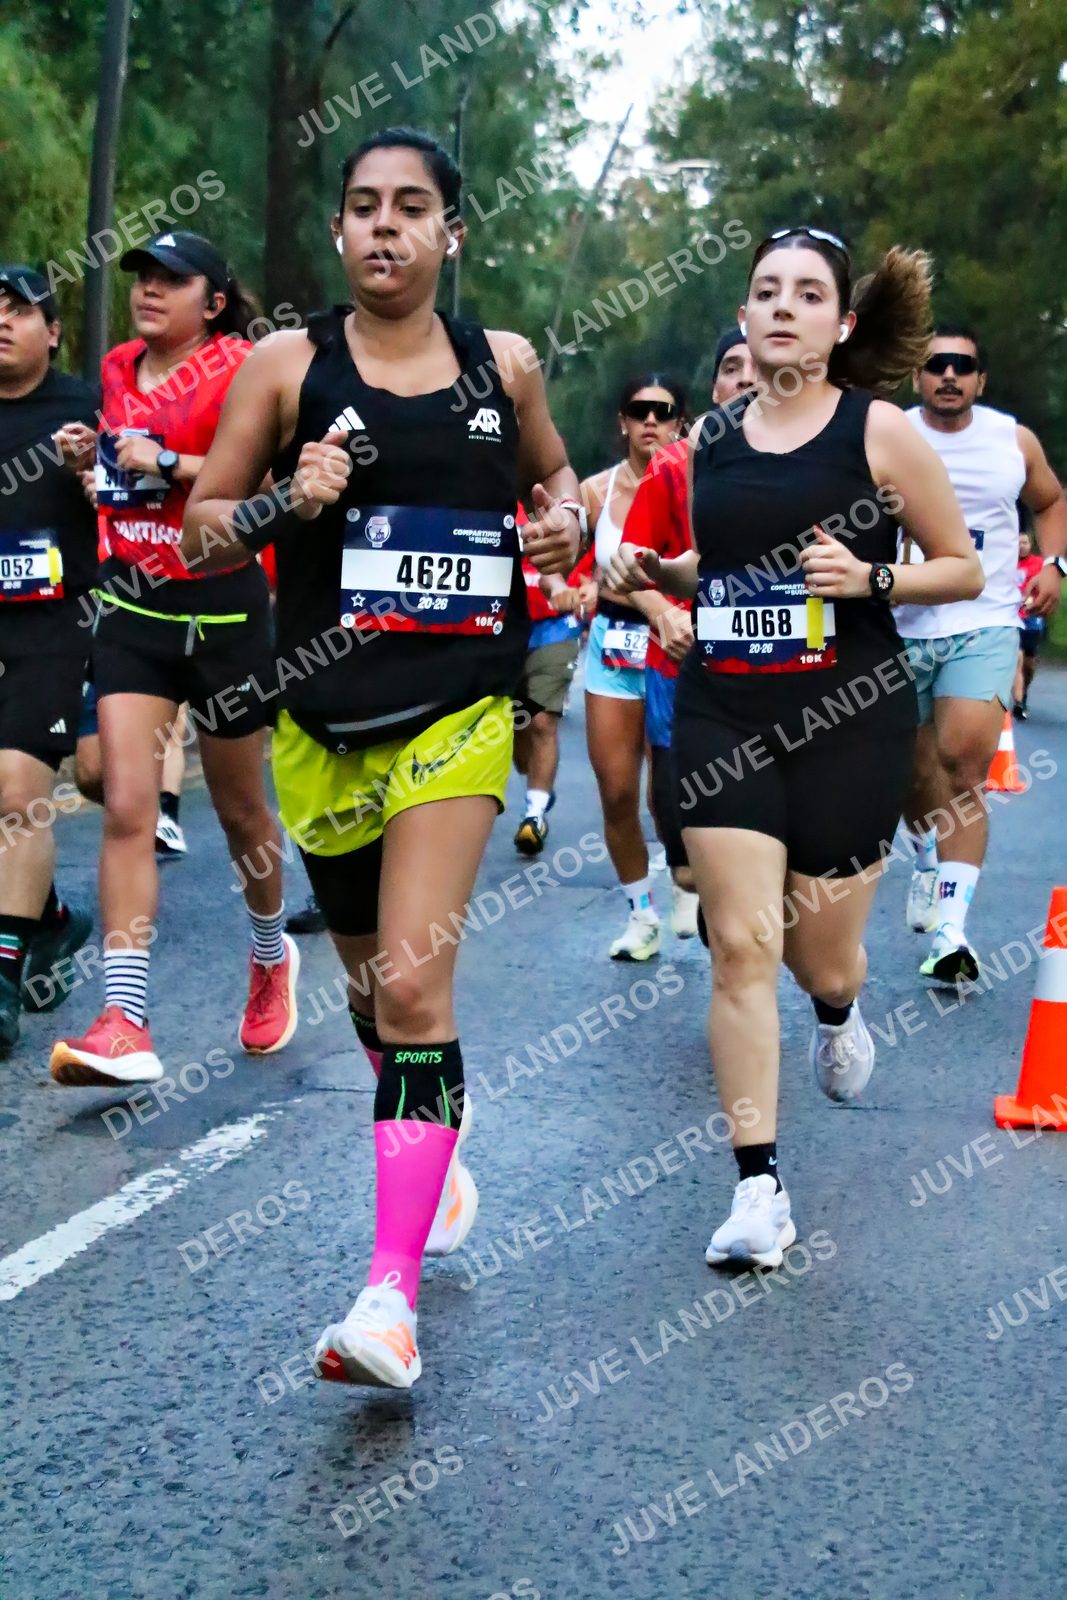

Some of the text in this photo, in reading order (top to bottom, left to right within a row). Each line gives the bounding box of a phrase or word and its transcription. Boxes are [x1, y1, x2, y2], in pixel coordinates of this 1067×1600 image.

[397, 555, 472, 591] 4628
[475, 616, 494, 626] 10K
[732, 608, 792, 637] 4068
[800, 654, 822, 664] 10K
[394, 1051, 443, 1064] SPORTS
